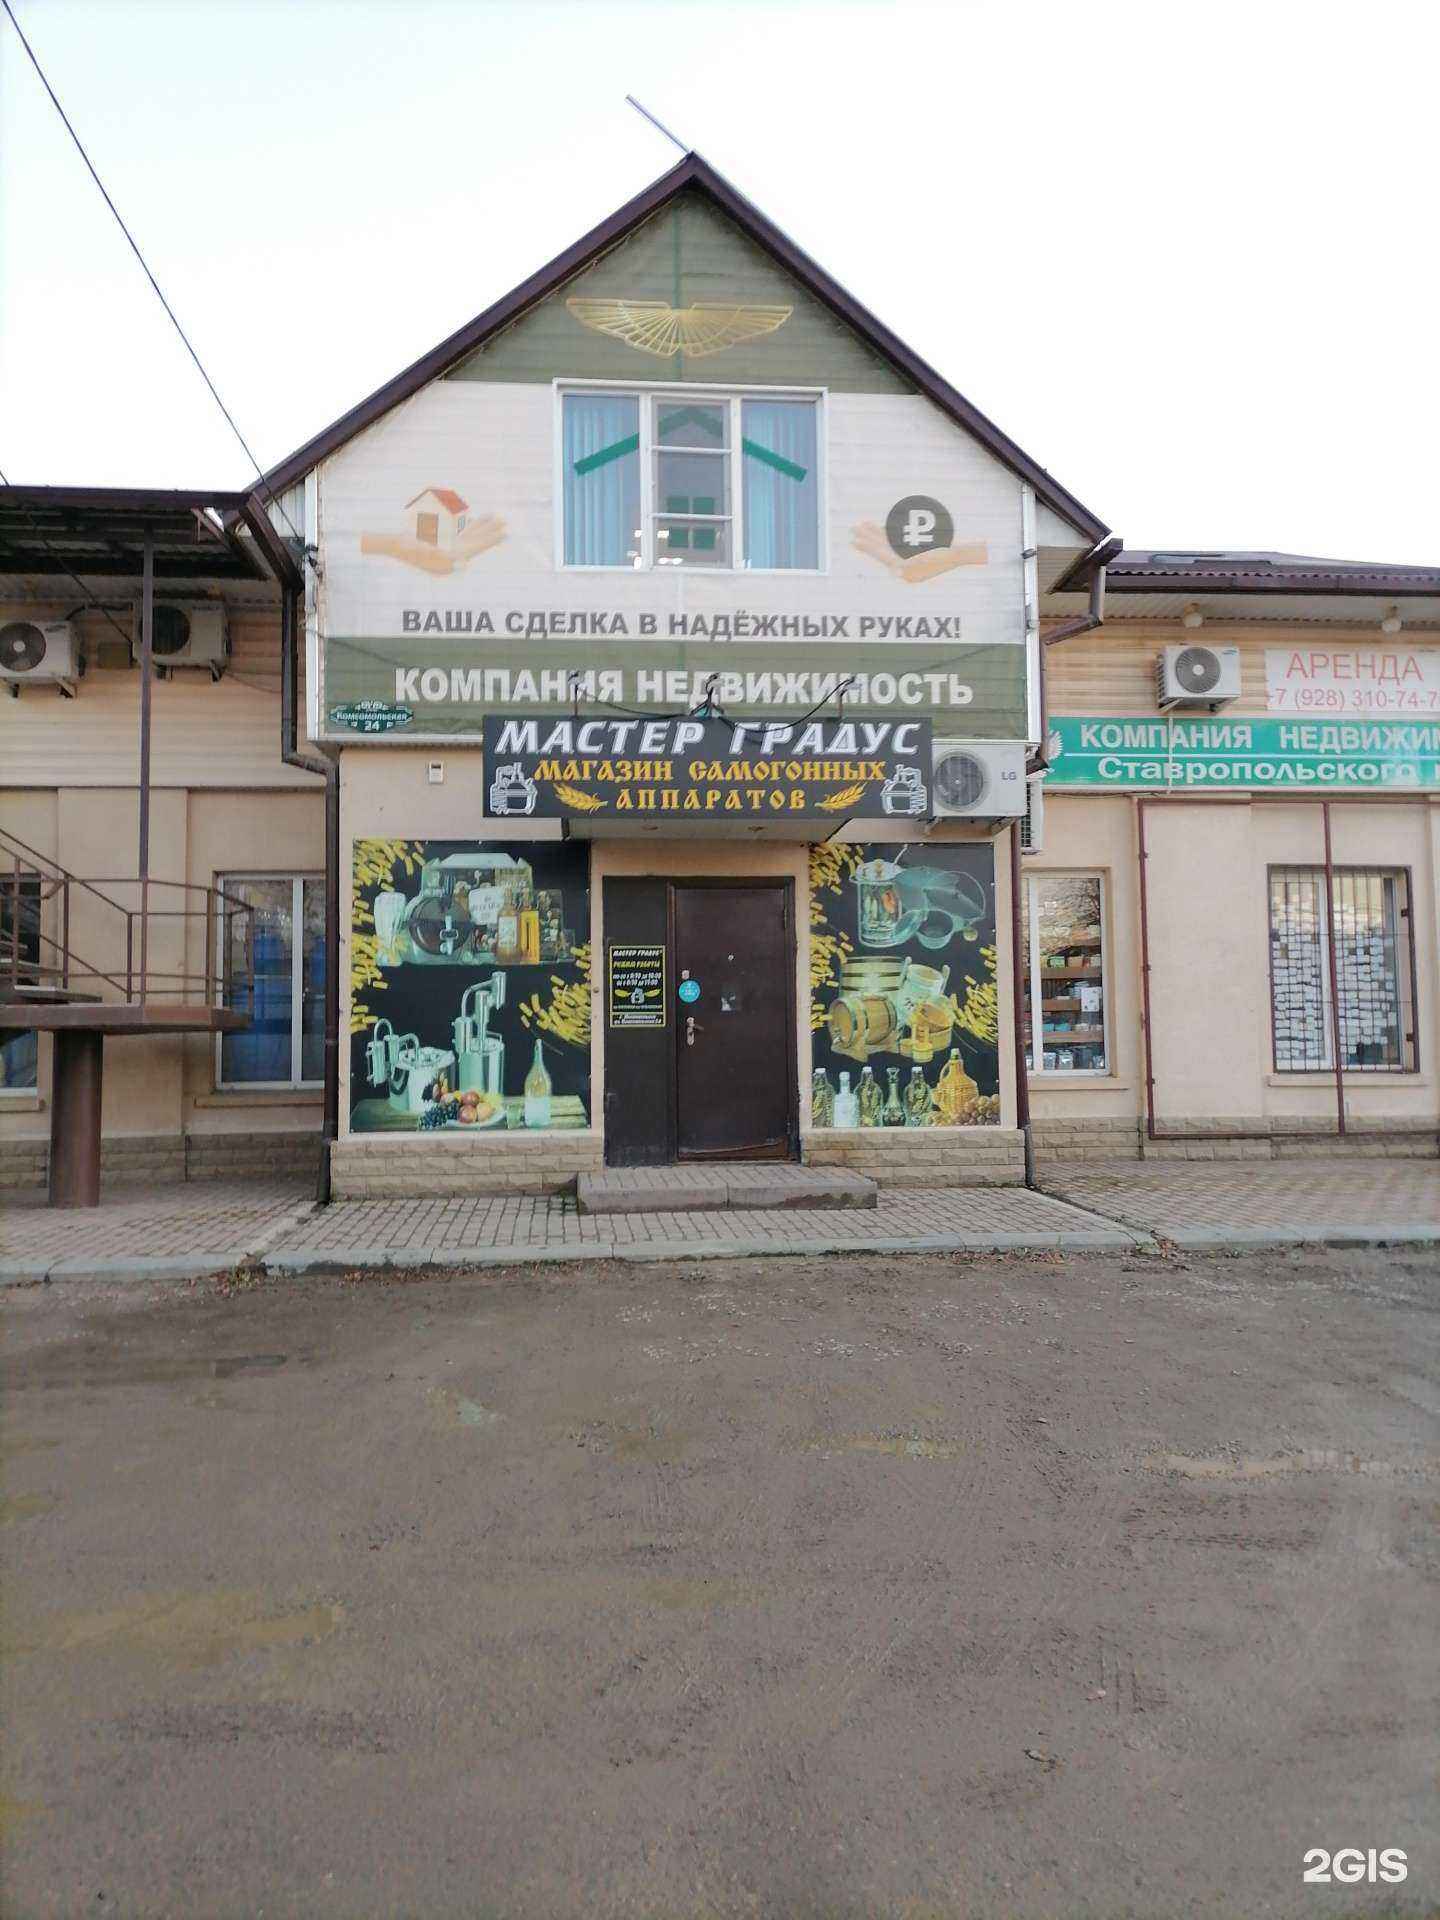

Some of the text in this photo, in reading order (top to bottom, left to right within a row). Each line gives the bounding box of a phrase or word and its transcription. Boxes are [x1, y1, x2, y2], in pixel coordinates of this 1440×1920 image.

[402, 609, 960, 641] ВАША СДЕЛКА В НАДЁЖНЫХ РУКАХ!
[1286, 652, 1424, 686] АРЕНДА
[395, 668, 973, 705] КОМПАНИЯ НЕДВИЖИМОСТЬ
[364, 721, 379, 731] 24
[494, 719, 922, 756] МАСТЕР ГРАДУС
[1081, 724, 1252, 749] КОМПАНИЯ
[533, 759, 887, 784] МАГАЗИН САМОГОННЫХ
[1001, 771, 1017, 780] LG
[1098, 756, 1419, 784] Ставропольского
[616, 787, 806, 810] АППАРАТОВ
